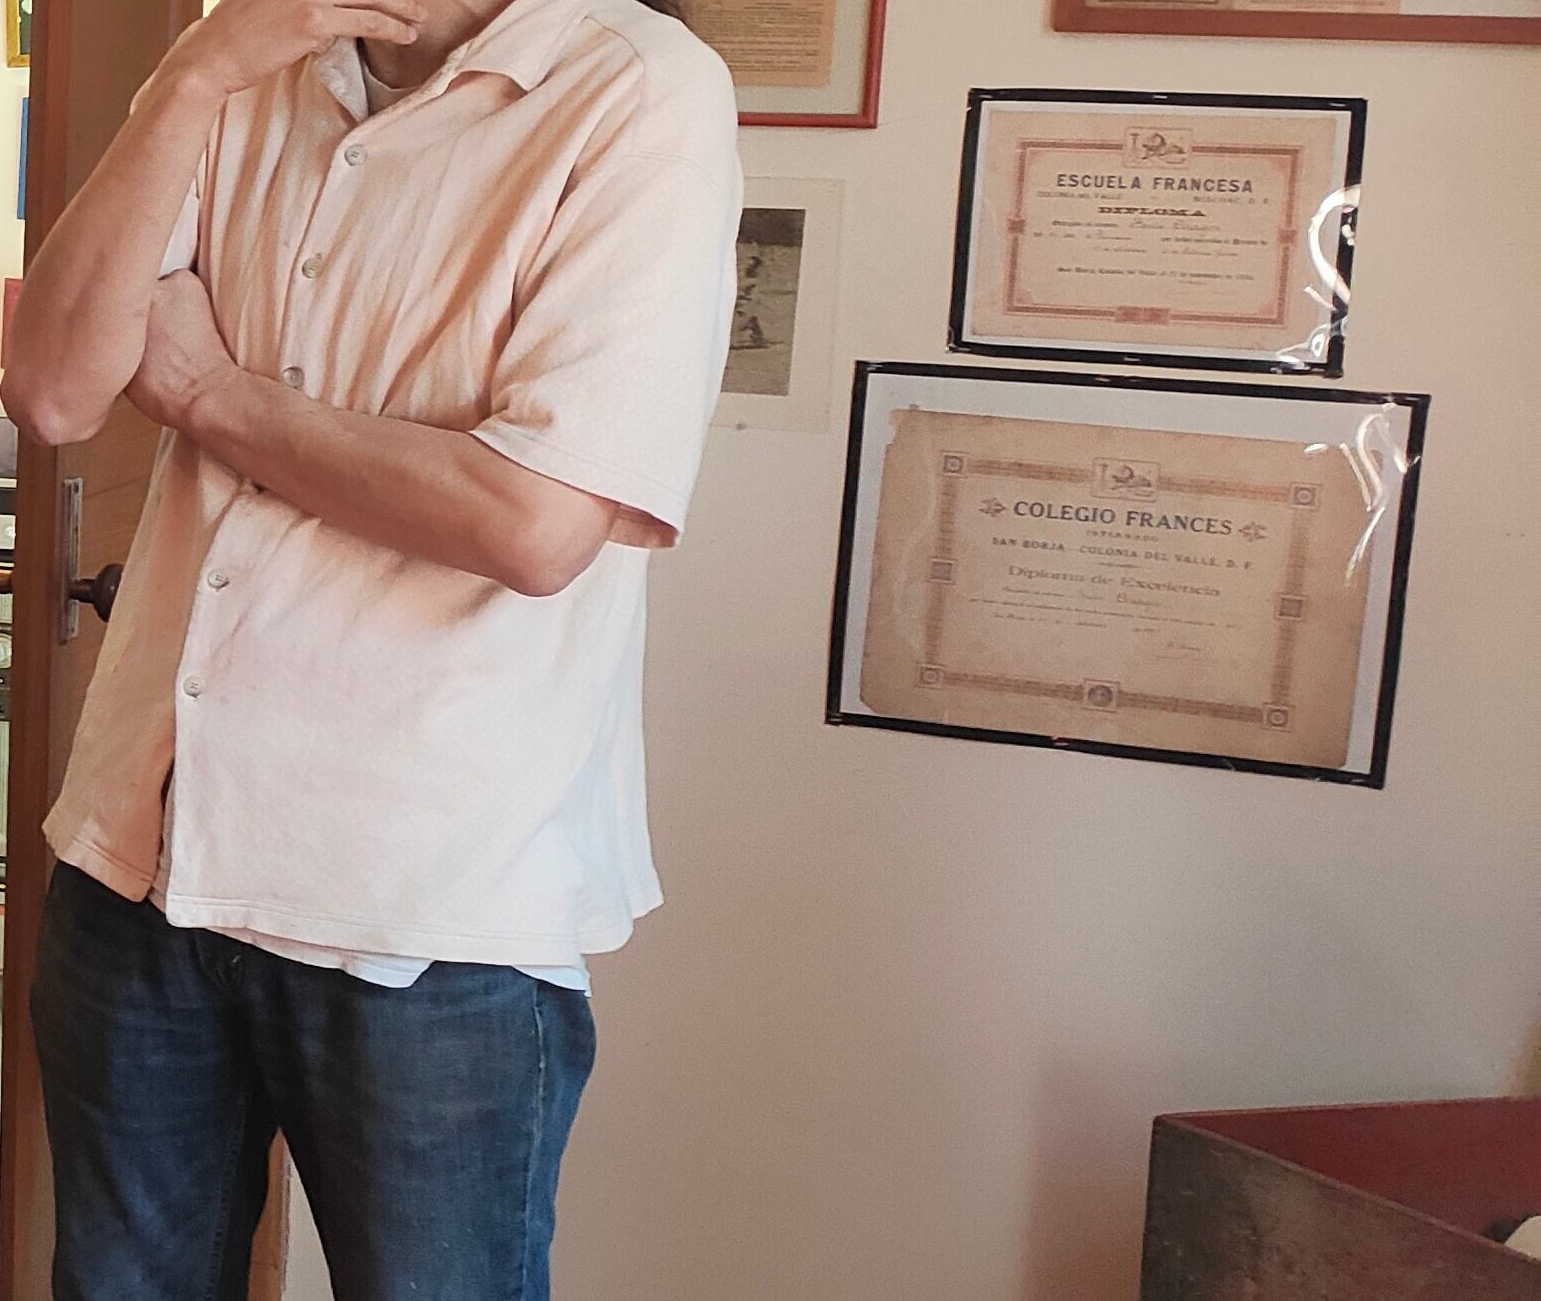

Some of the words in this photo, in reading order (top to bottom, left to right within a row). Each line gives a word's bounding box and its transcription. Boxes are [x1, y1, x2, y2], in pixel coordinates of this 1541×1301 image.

[1056, 173, 1142, 190] ESCUELA
[1152, 177, 1254, 193] FRANCESA
[1097, 206, 1207, 217] DIPLOMA
[1013, 500, 1117, 525] COLEGIO
[1125, 510, 1234, 536] FRANCES
[992, 536, 1017, 547] SAN
[1078, 545, 1139, 559] COLONIA
